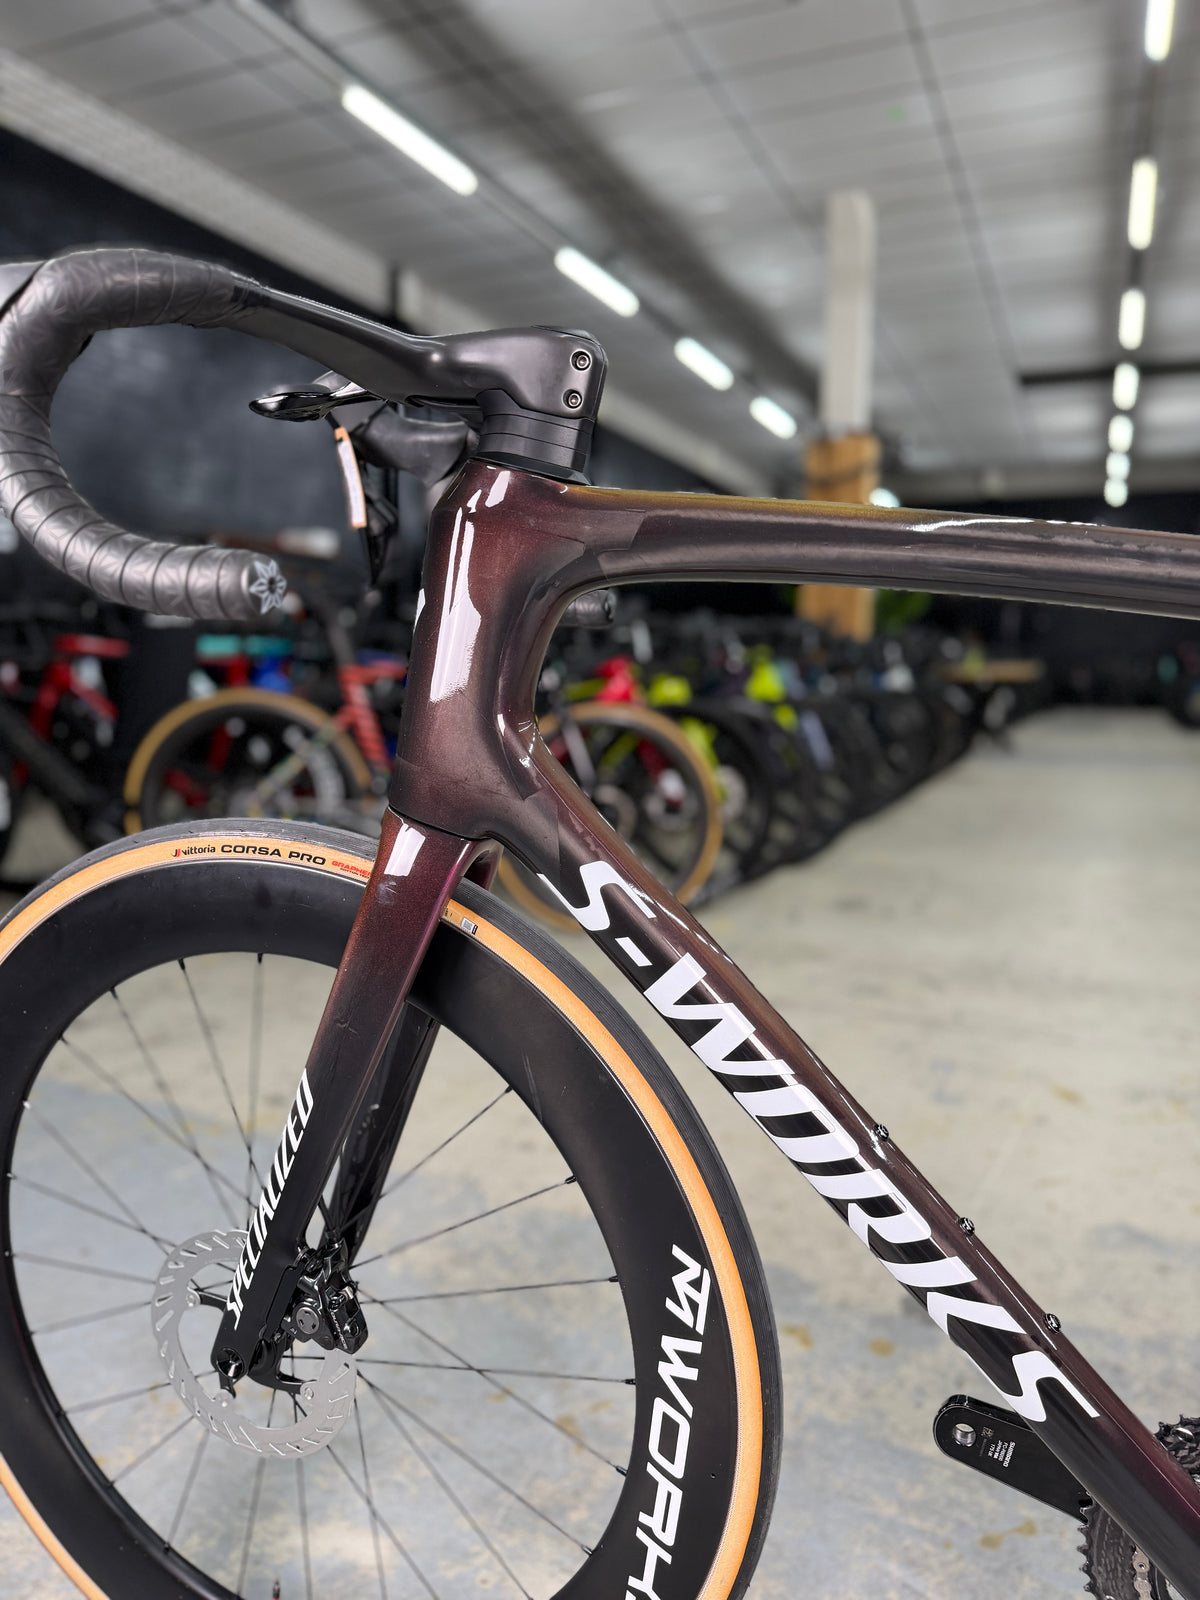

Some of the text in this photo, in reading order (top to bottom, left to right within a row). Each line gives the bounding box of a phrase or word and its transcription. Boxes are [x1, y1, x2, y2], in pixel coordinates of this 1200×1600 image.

[182, 844, 326, 866] vittoria CORSA PRO
[227, 1068, 314, 1331] SPECIALIZED
[536, 861, 1101, 1423] S-WORKS
